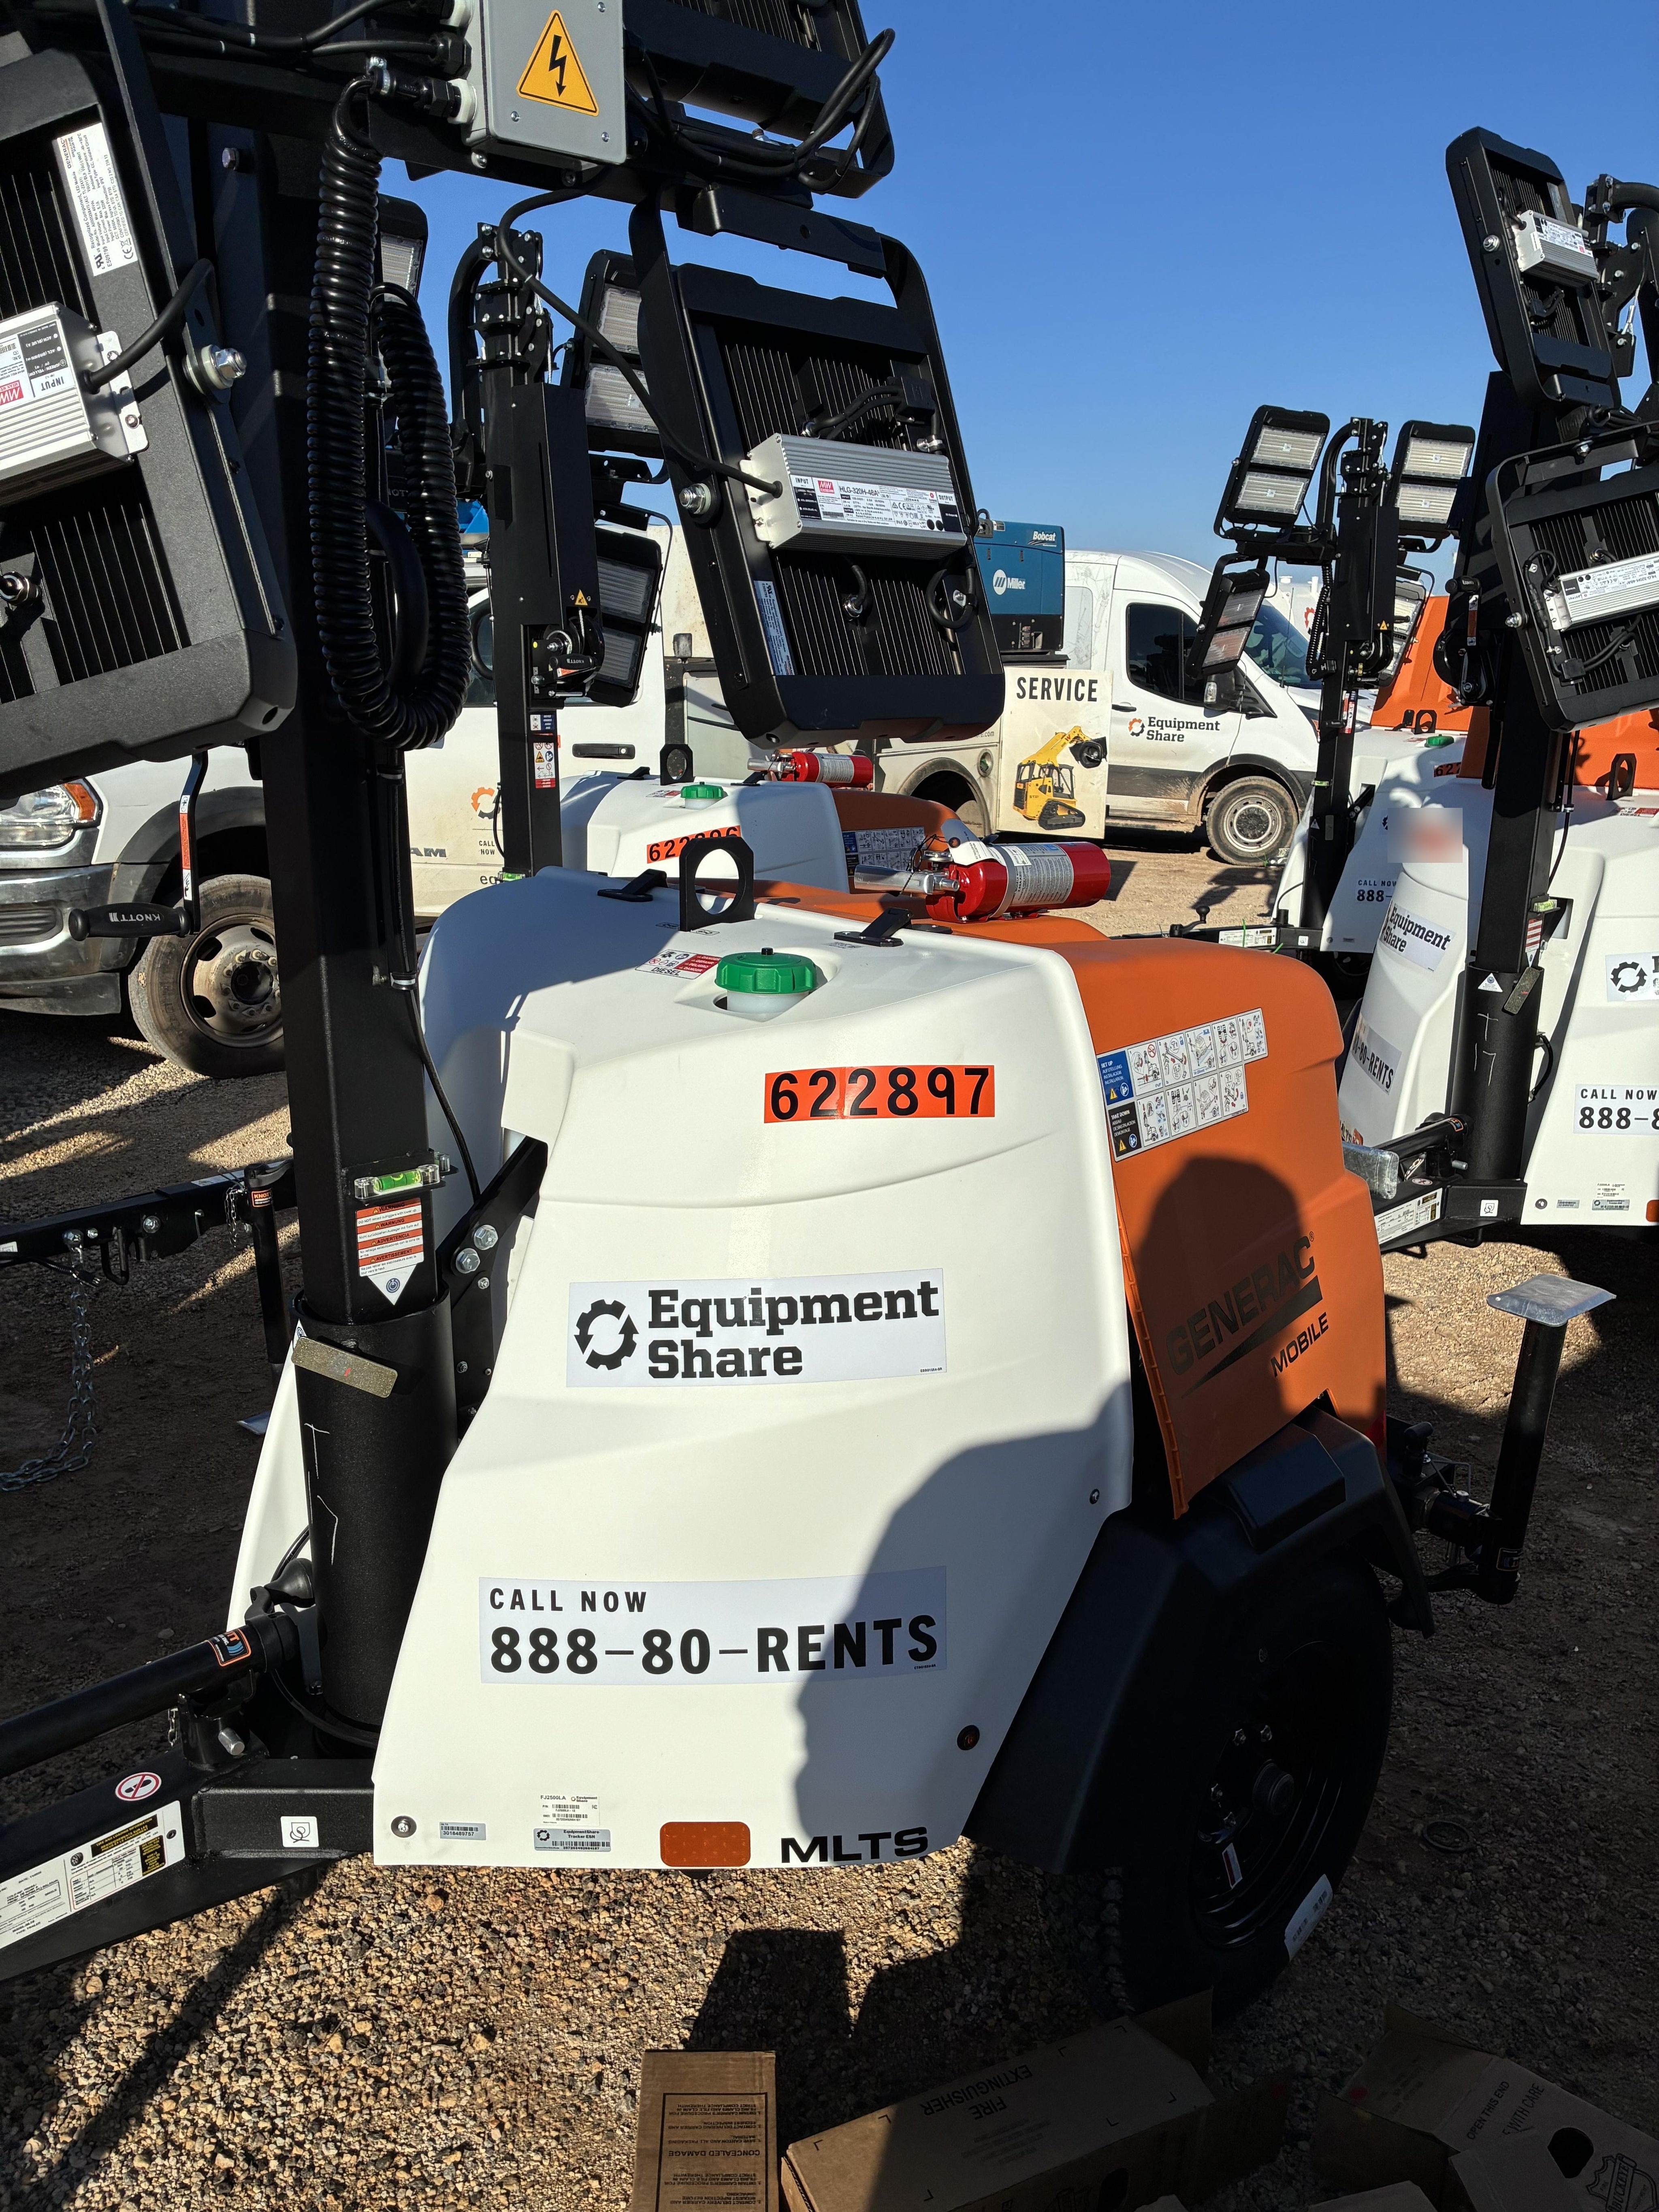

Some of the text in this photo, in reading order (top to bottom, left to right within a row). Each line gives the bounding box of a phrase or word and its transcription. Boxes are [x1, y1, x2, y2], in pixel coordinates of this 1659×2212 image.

[84, 221, 96, 249] Recognized
[39, 376, 64, 391] INPUT
[839, 486, 878, 496] HLG-320H-48A
[1033, 531, 1056, 541] Bobcat
[1008, 578, 1026, 589] Miller
[1017, 677, 1098, 702] SERVICE
[1147, 730, 1184, 742] Share
[1148, 717, 1220, 731] Equipment
[120, 913, 161, 921] KNOTT
[1390, 906, 1451, 951] Equipment
[1384, 926, 1407, 952] Share
[650, 967, 683, 975] DIESEL
[772, 1067, 989, 1120] 622897
[1580, 1089, 1658, 1100] CALL NOW
[379, 1202, 405, 1212] WARNING
[380, 1218, 404, 1227] WARNUNG
[377, 1233, 409, 1244] ADVERTENCIA
[376, 1248, 412, 1261] AVERTISSEMENT
[648, 1280, 939, 1337] Equipment
[1167, 1236, 1315, 1375] GENERAC
[1271, 1312, 1329, 1377] MOBILE
[648, 1339, 803, 1378] Share
[490, 1588, 647, 1613] CALL NOW
[491, 1615, 938, 1674] 888-80-RENTS
[781, 1826, 928, 1863] MLTS
[919, 2060, 1032, 2120] EXTINGUISHER
[968, 2094, 1006, 2122] FIRE
[1466, 2080, 1510, 2142] OPEN THIS END
[1505, 2082, 1545, 2132] WITH CARE
